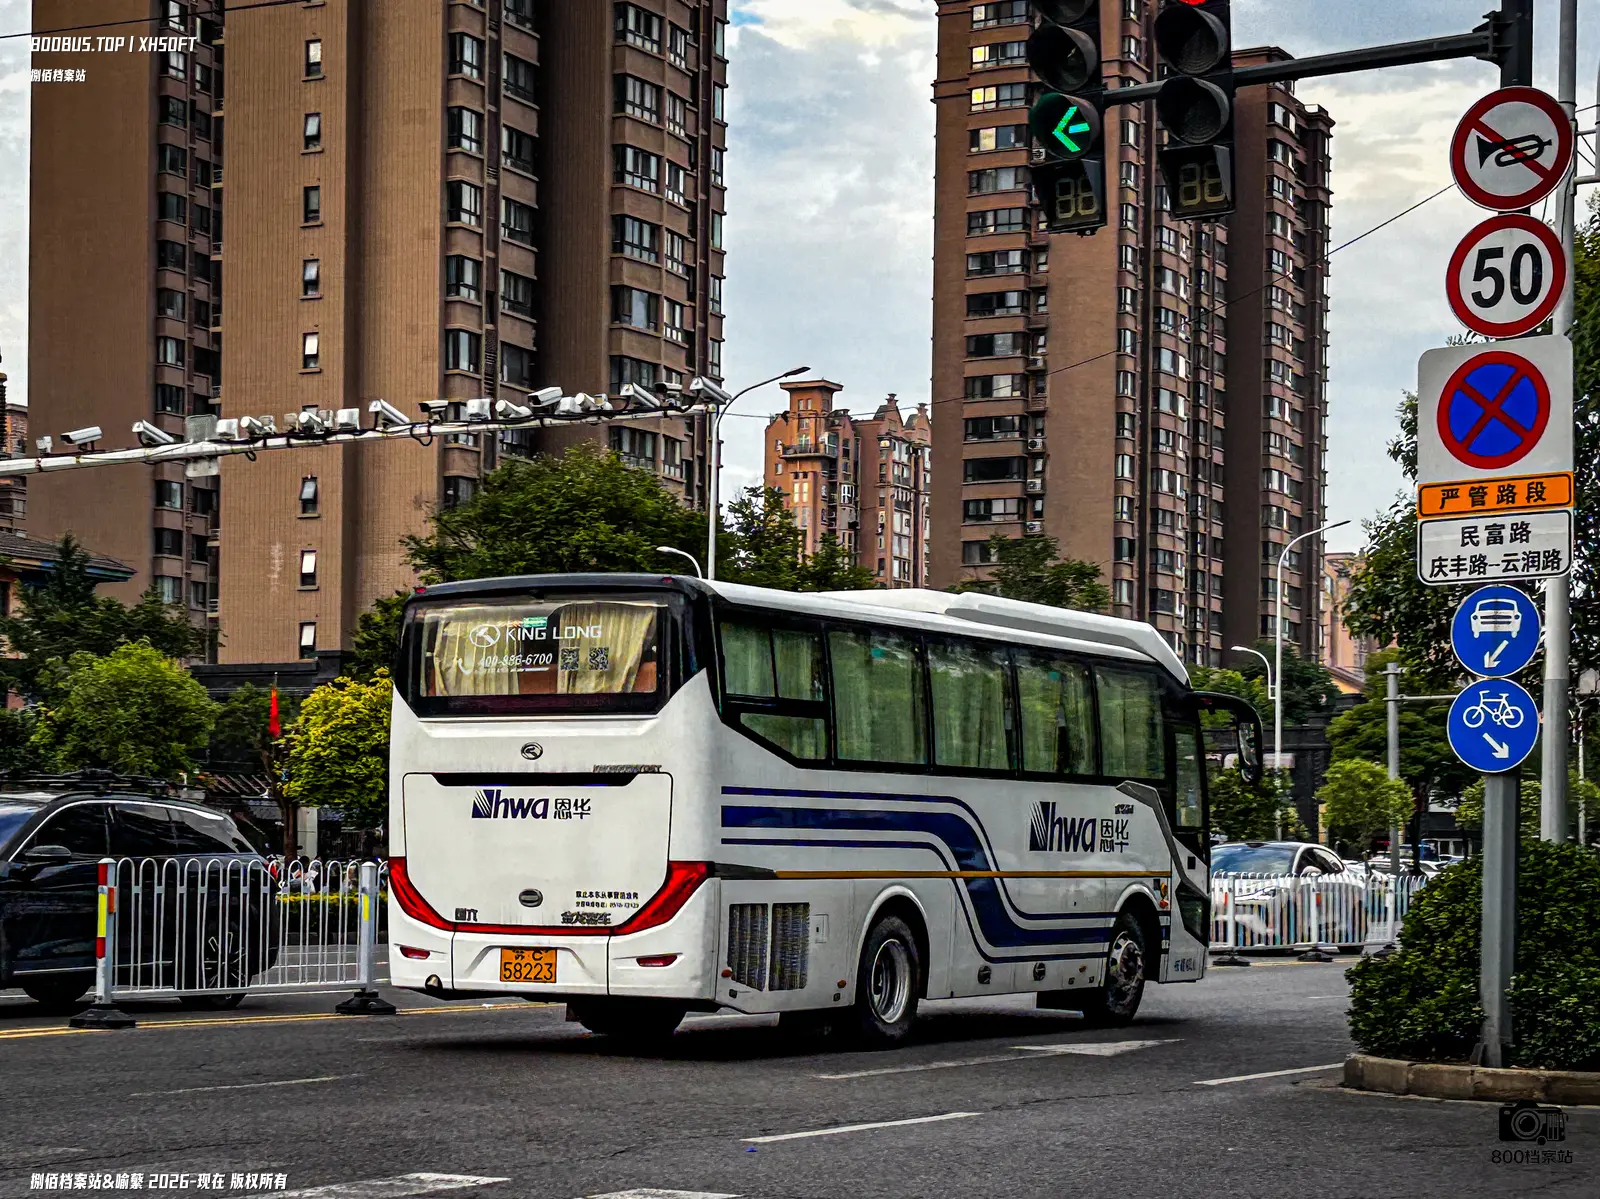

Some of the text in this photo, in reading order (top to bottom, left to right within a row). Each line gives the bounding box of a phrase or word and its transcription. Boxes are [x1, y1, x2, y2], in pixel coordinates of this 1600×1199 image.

[1471, 243, 1543, 309] 50
[1439, 481, 1547, 510] 严管路段
[1460, 521, 1532, 548] 民富路
[506, 625, 602, 641] KING LONG
[554, 798, 592, 820] 恩华
[1100, 818, 1130, 853] 恩华
[503, 962, 553, 980] 58223
